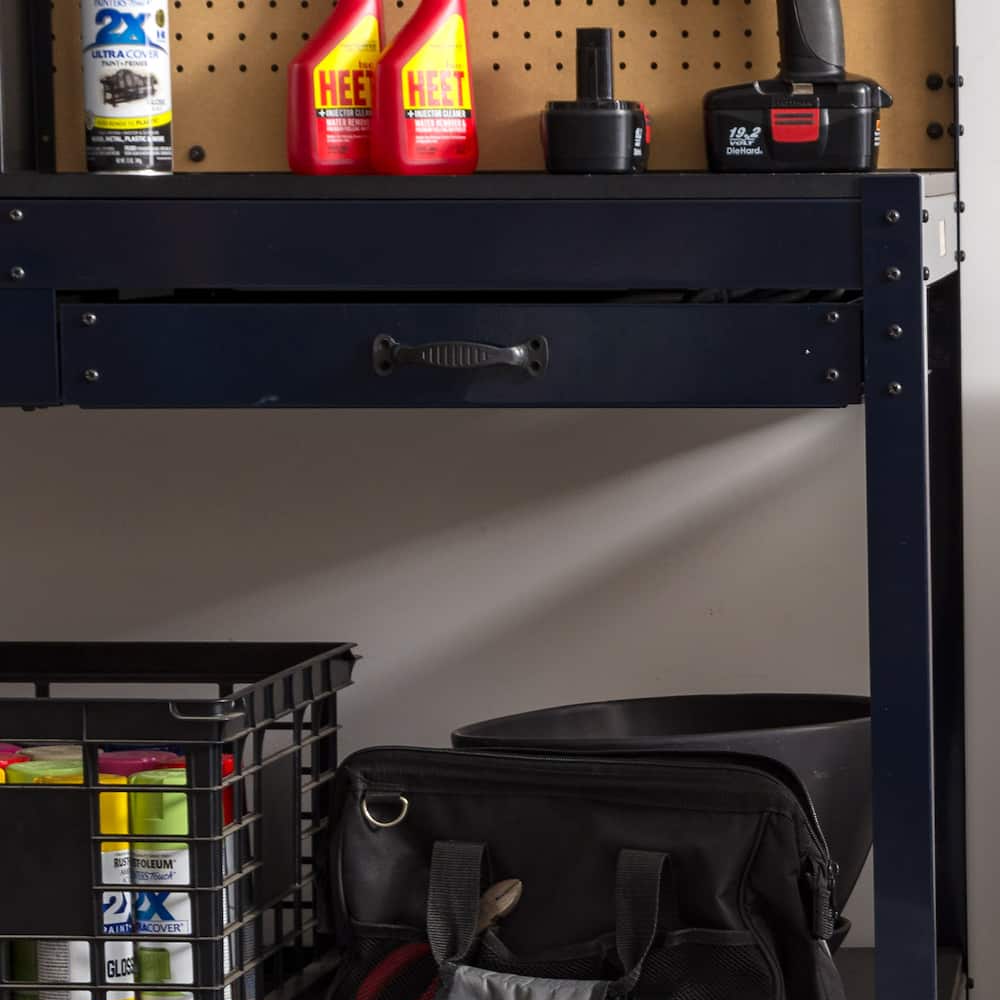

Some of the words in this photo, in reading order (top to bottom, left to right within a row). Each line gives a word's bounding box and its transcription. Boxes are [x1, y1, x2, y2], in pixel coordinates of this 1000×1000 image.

[95, 8, 146, 46] 2X
[408, 71, 465, 107] HEET
[729, 126, 762, 138] 19.2
[726, 146, 761, 156] DieHard
